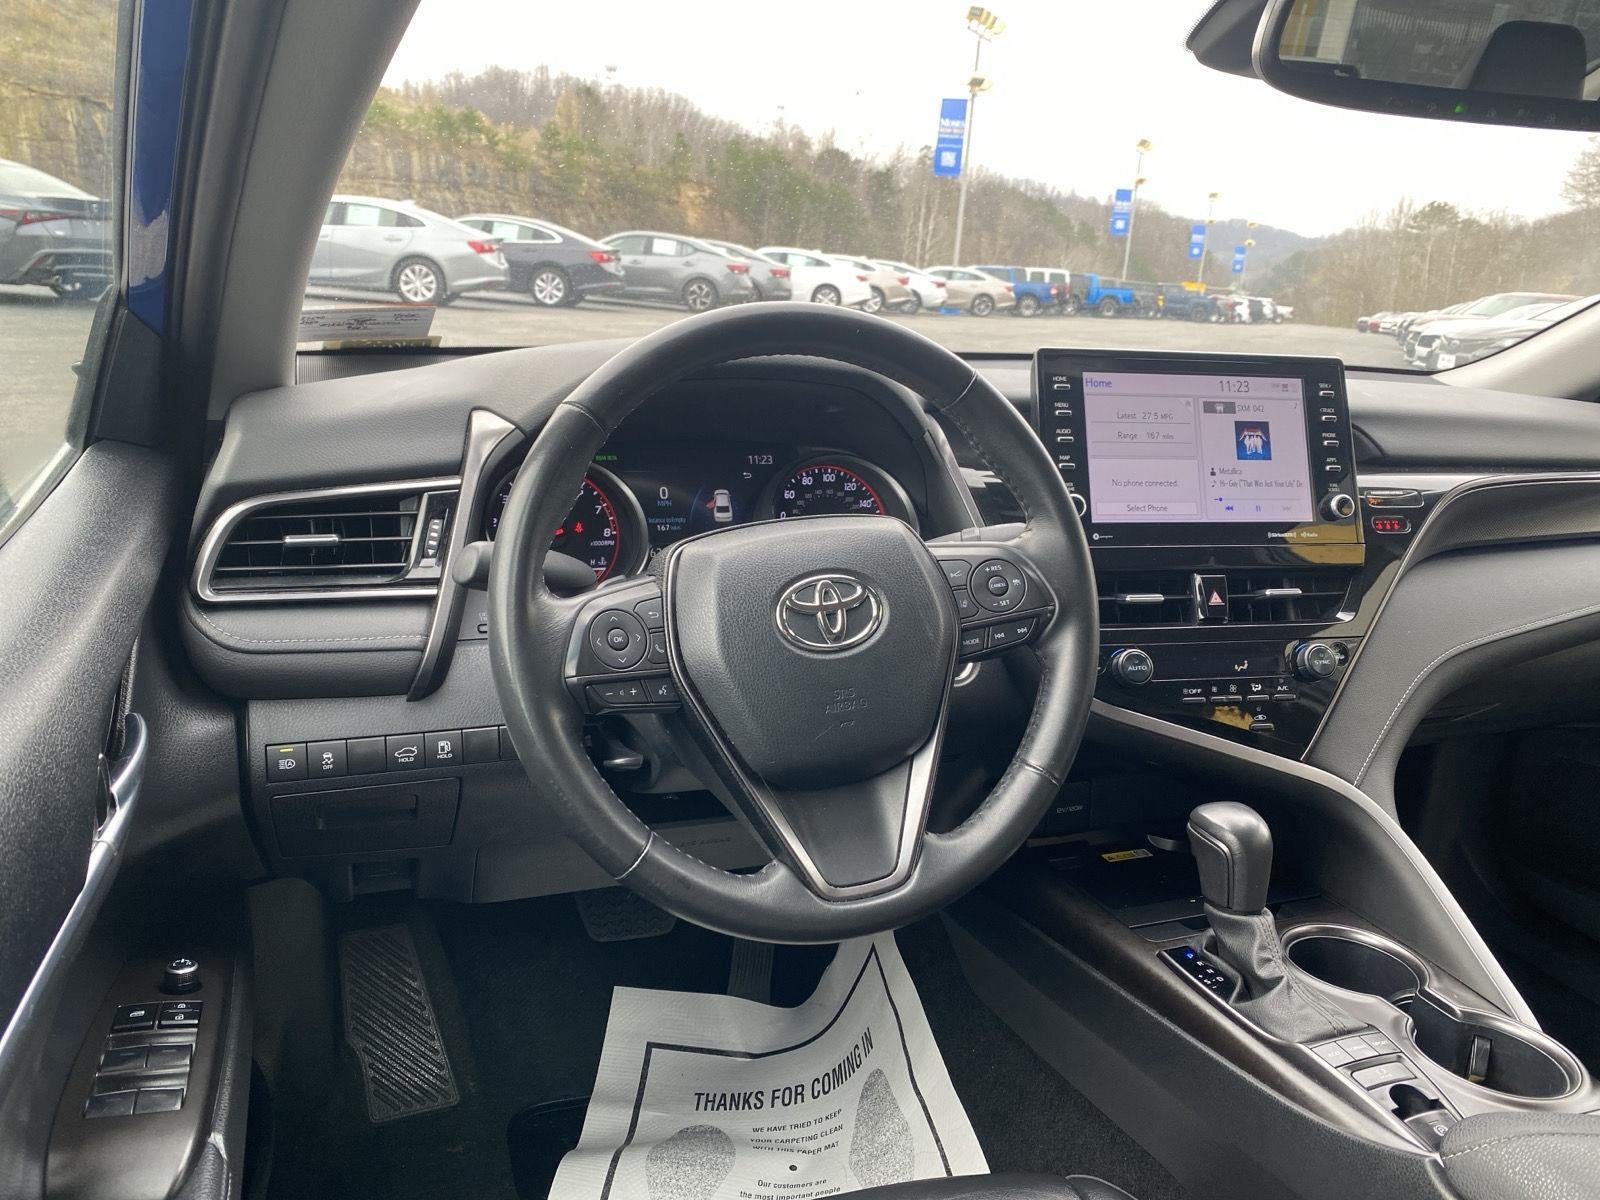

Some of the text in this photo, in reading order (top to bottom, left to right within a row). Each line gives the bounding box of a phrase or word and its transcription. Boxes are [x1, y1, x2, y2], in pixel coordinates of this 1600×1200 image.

[1085, 378, 1112, 388] Home
[1218, 380, 1250, 393] 11:23
[1116, 411, 1137, 419] Latest
[1142, 412, 1159, 420] 27.5
[1117, 431, 1138, 440] Range
[1146, 432, 1160, 440] 167
[748, 455, 773, 465] 11:23
[802, 477, 813, 485] 80
[822, 473, 836, 482] 100
[844, 482, 857, 491] 120
[1111, 479, 1178, 488] No phone connected
[659, 486, 669, 500] 0
[784, 490, 795, 499] 60
[859, 499, 872, 508] 140
[1126, 504, 1168, 512] Select Phone
[595, 505, 602, 514] 7
[603, 528, 611, 538] 8
[962, 638, 980, 646] MODE
[694, 1026, 874, 1112] THANKS FOR COMING IN
[766, 1124, 787, 1132] HAVE
[789, 1120, 812, 1131] TRIED
[813, 1117, 823, 1126] TO
[825, 1108, 842, 1120] KEEP
[774, 1133, 819, 1144] CARPETING
[820, 1123, 843, 1138] CLEAN
[797, 1147, 822, 1156] PAPER
[823, 1140, 840, 1151] MAT
[757, 1179, 772, 1187] Our
[773, 1181, 813, 1189] customers
[740, 1190, 753, 1198] the
[776, 1192, 813, 1200] important
[815, 1186, 841, 1197] people
